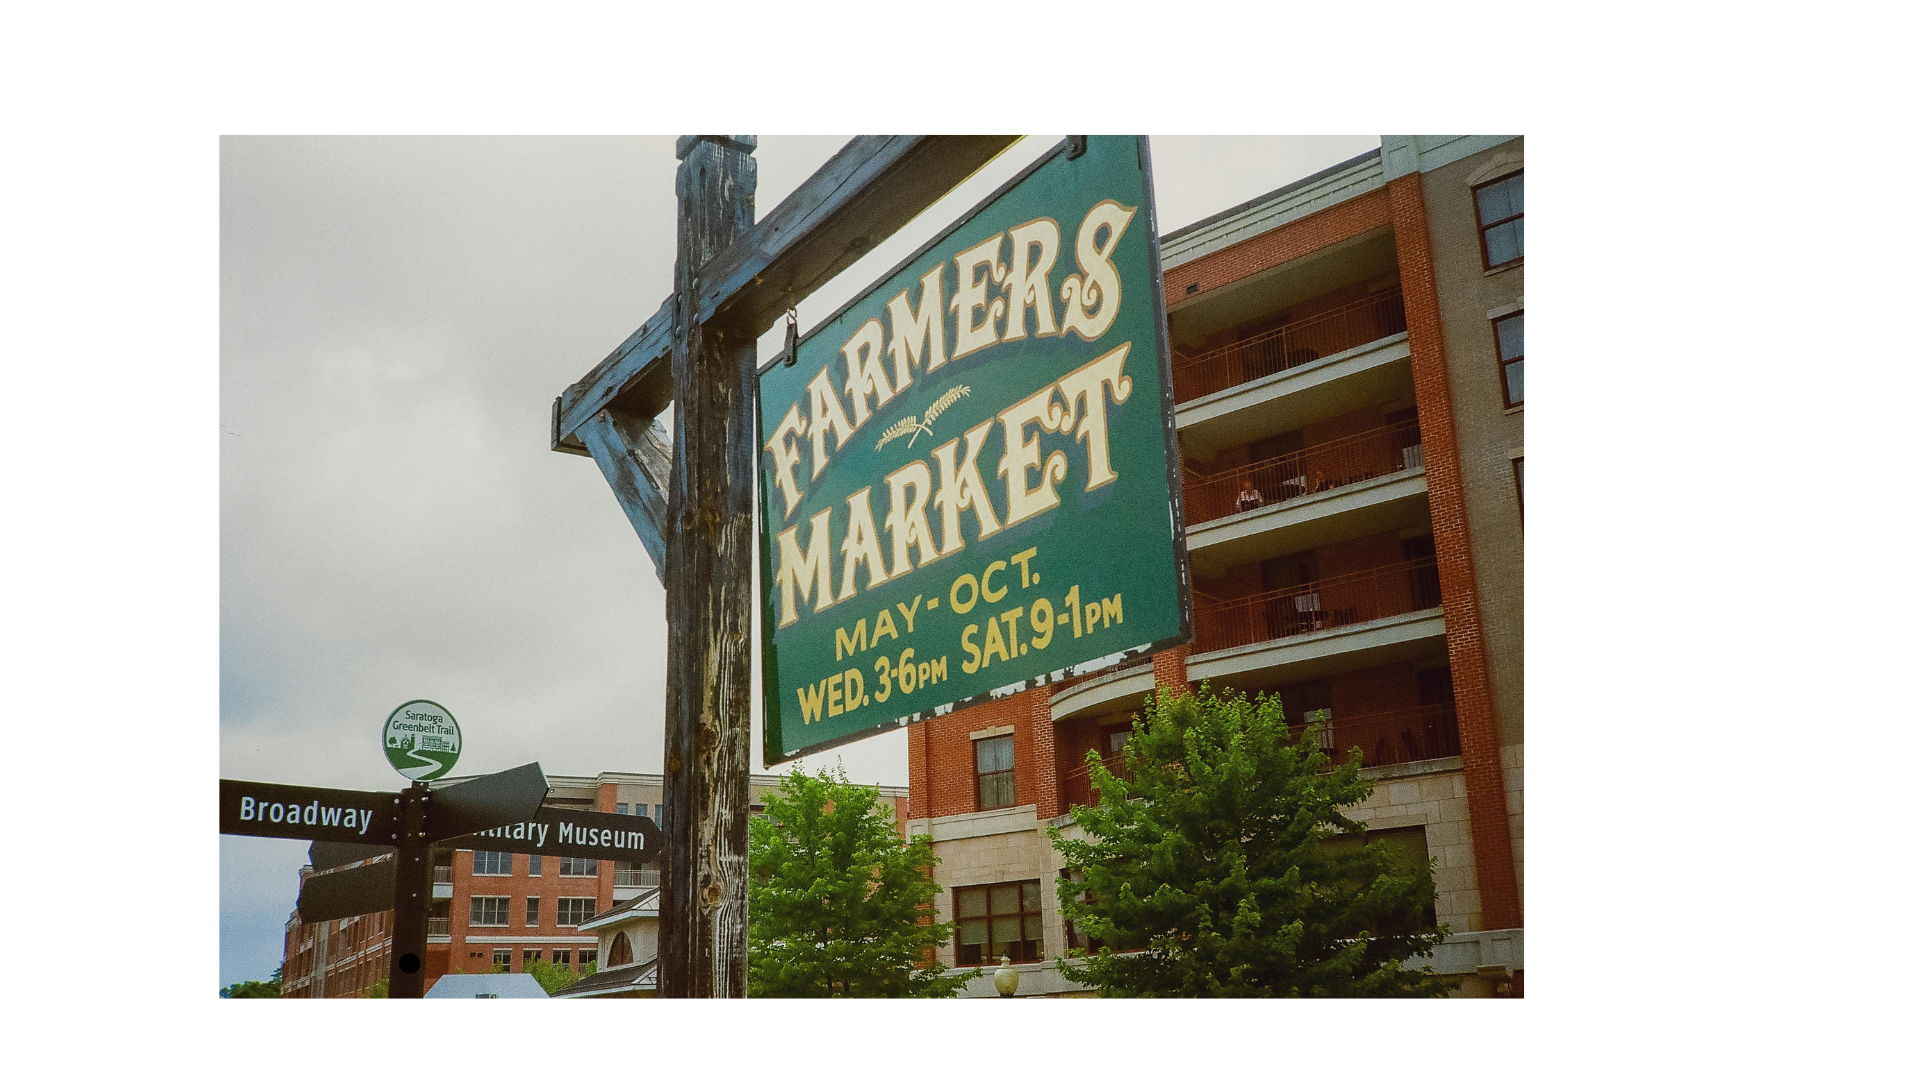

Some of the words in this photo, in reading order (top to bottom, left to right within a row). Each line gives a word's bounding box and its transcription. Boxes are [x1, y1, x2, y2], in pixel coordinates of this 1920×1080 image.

[764, 199, 1138, 519] FARMERS
[776, 341, 1132, 630] MARKET
[797, 669, 869, 725] WED.
[961, 606, 1028, 674] SAT.
[392, 720, 435, 733] Greenbelt
[436, 724, 454, 735] Trail
[405, 710, 443, 724] Saratoga
[240, 796, 373, 835] Broadway
[558, 822, 645, 850] Museum
